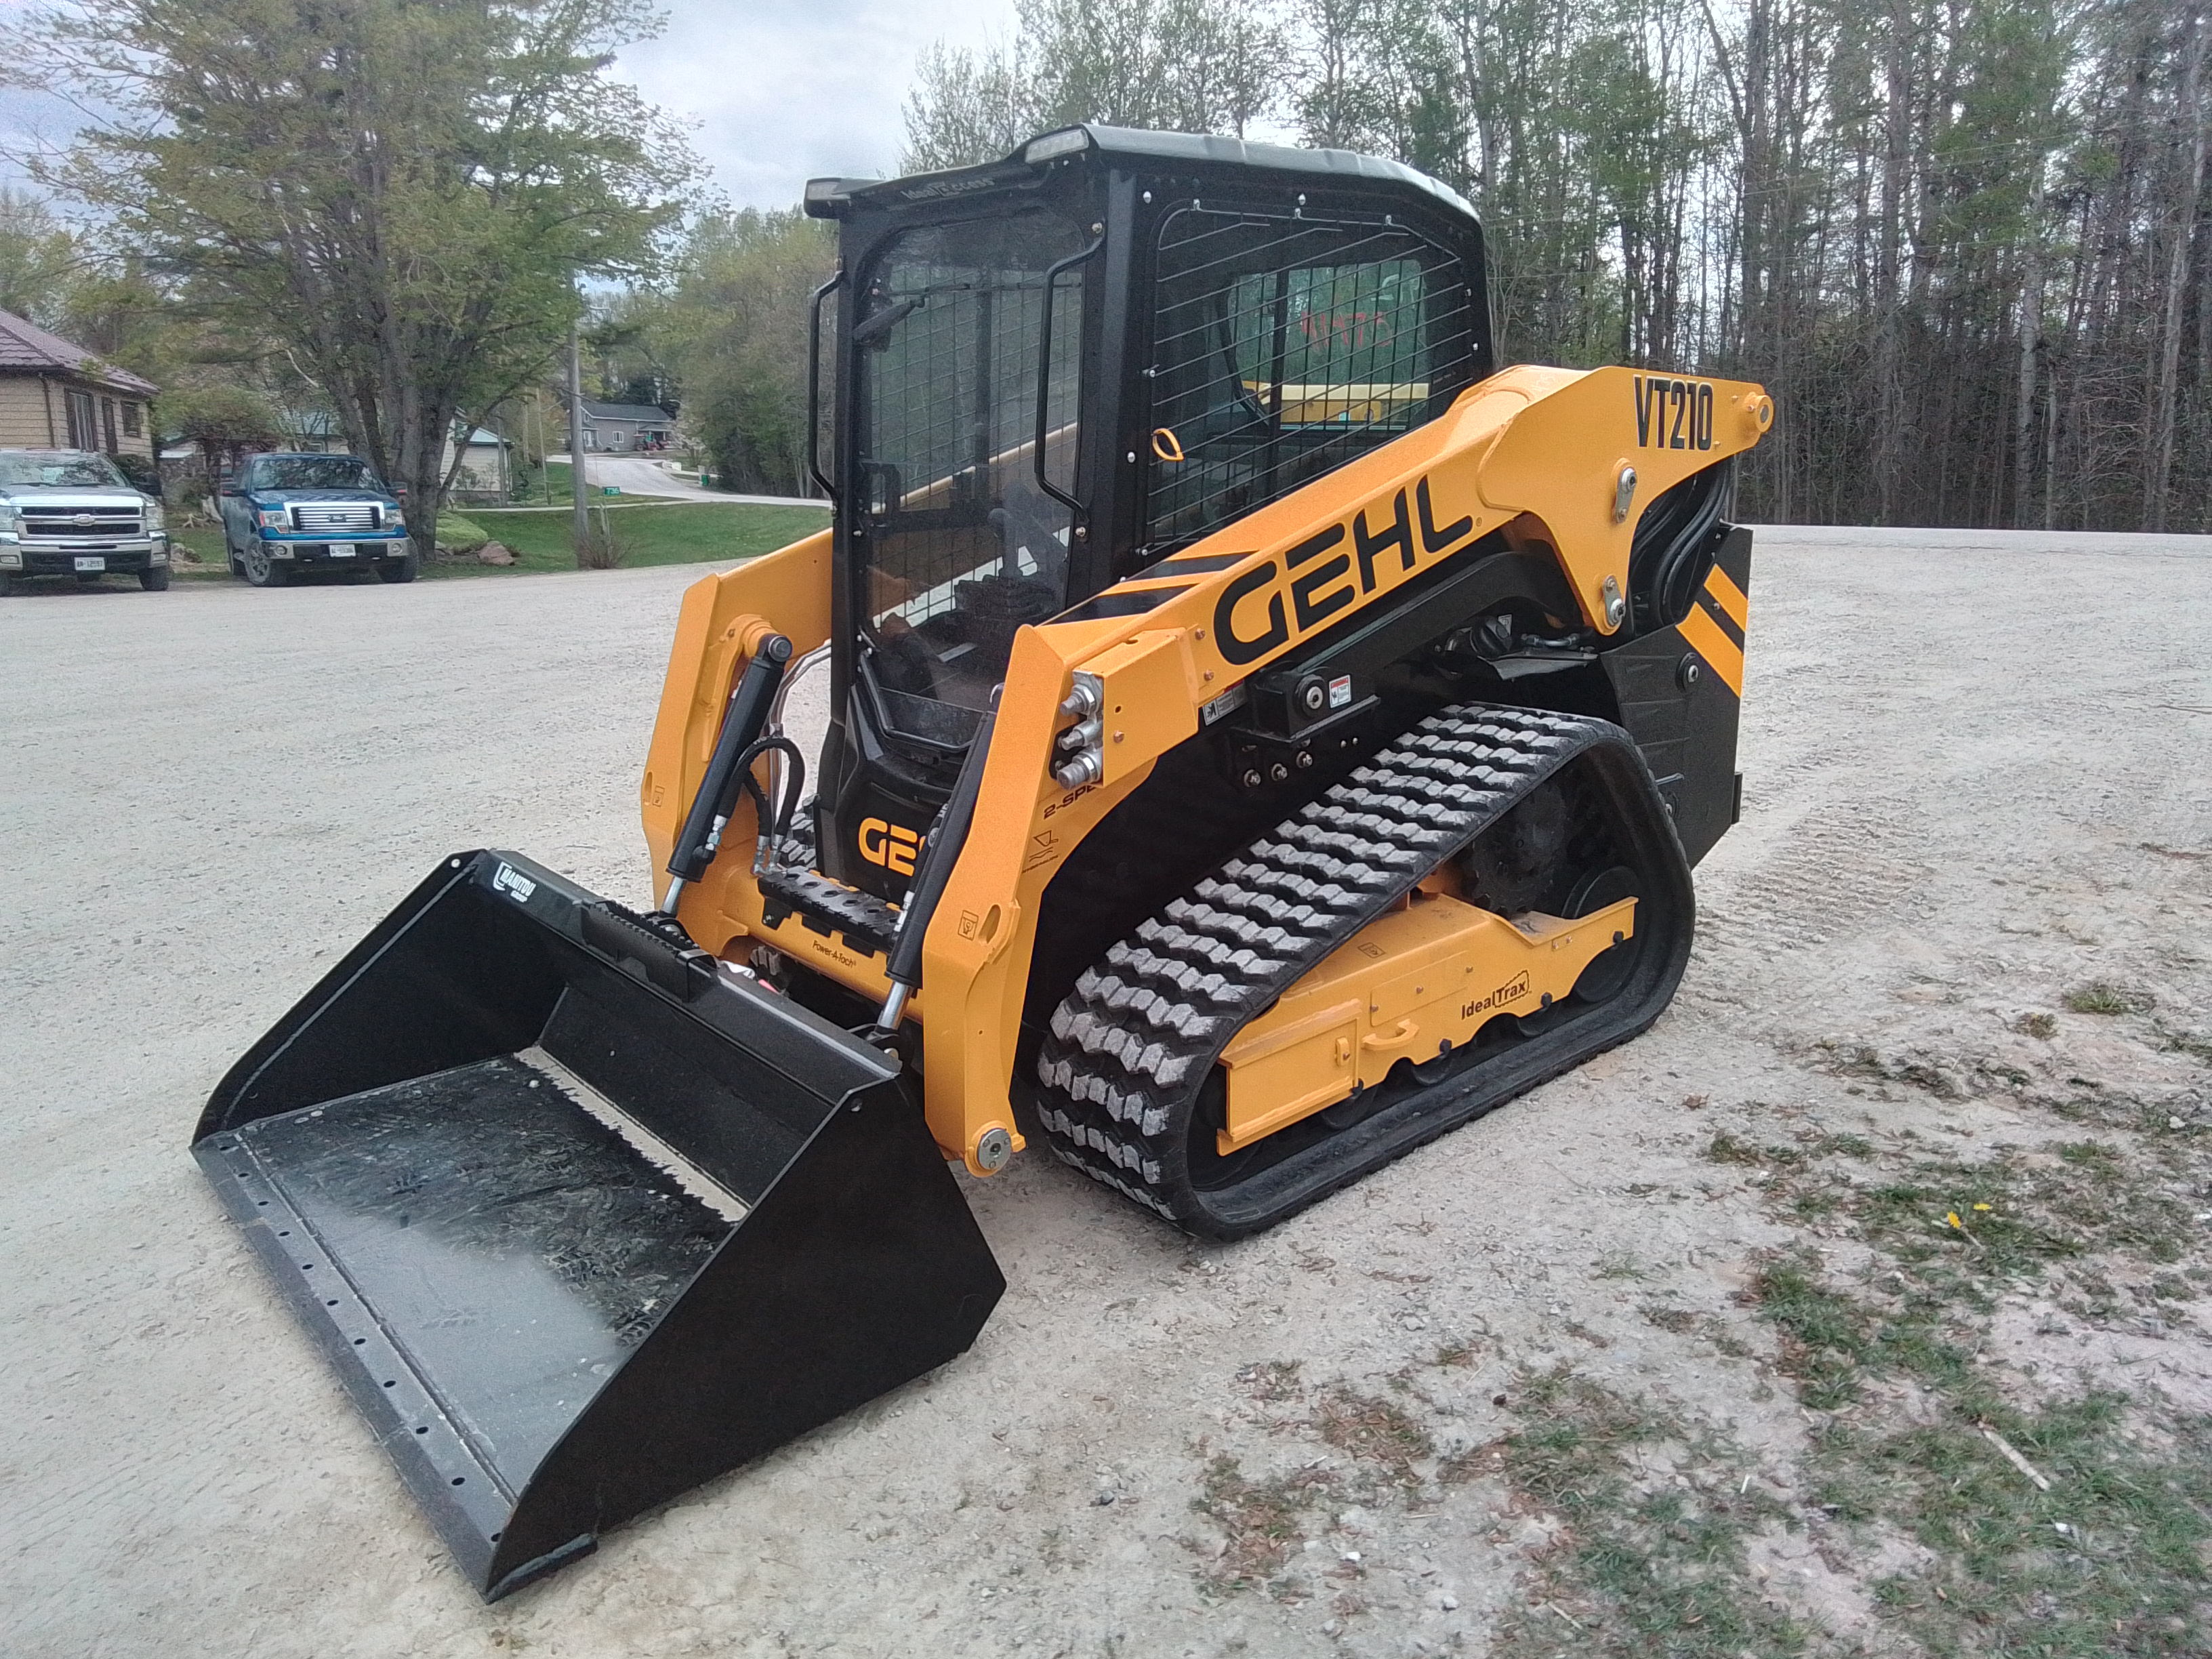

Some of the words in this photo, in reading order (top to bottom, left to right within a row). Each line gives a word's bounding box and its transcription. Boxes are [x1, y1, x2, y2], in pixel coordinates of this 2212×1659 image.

[1633, 375, 1713, 451] VT210
[1214, 474, 1473, 665] GEHL
[498, 867, 537, 897] MANITOU
